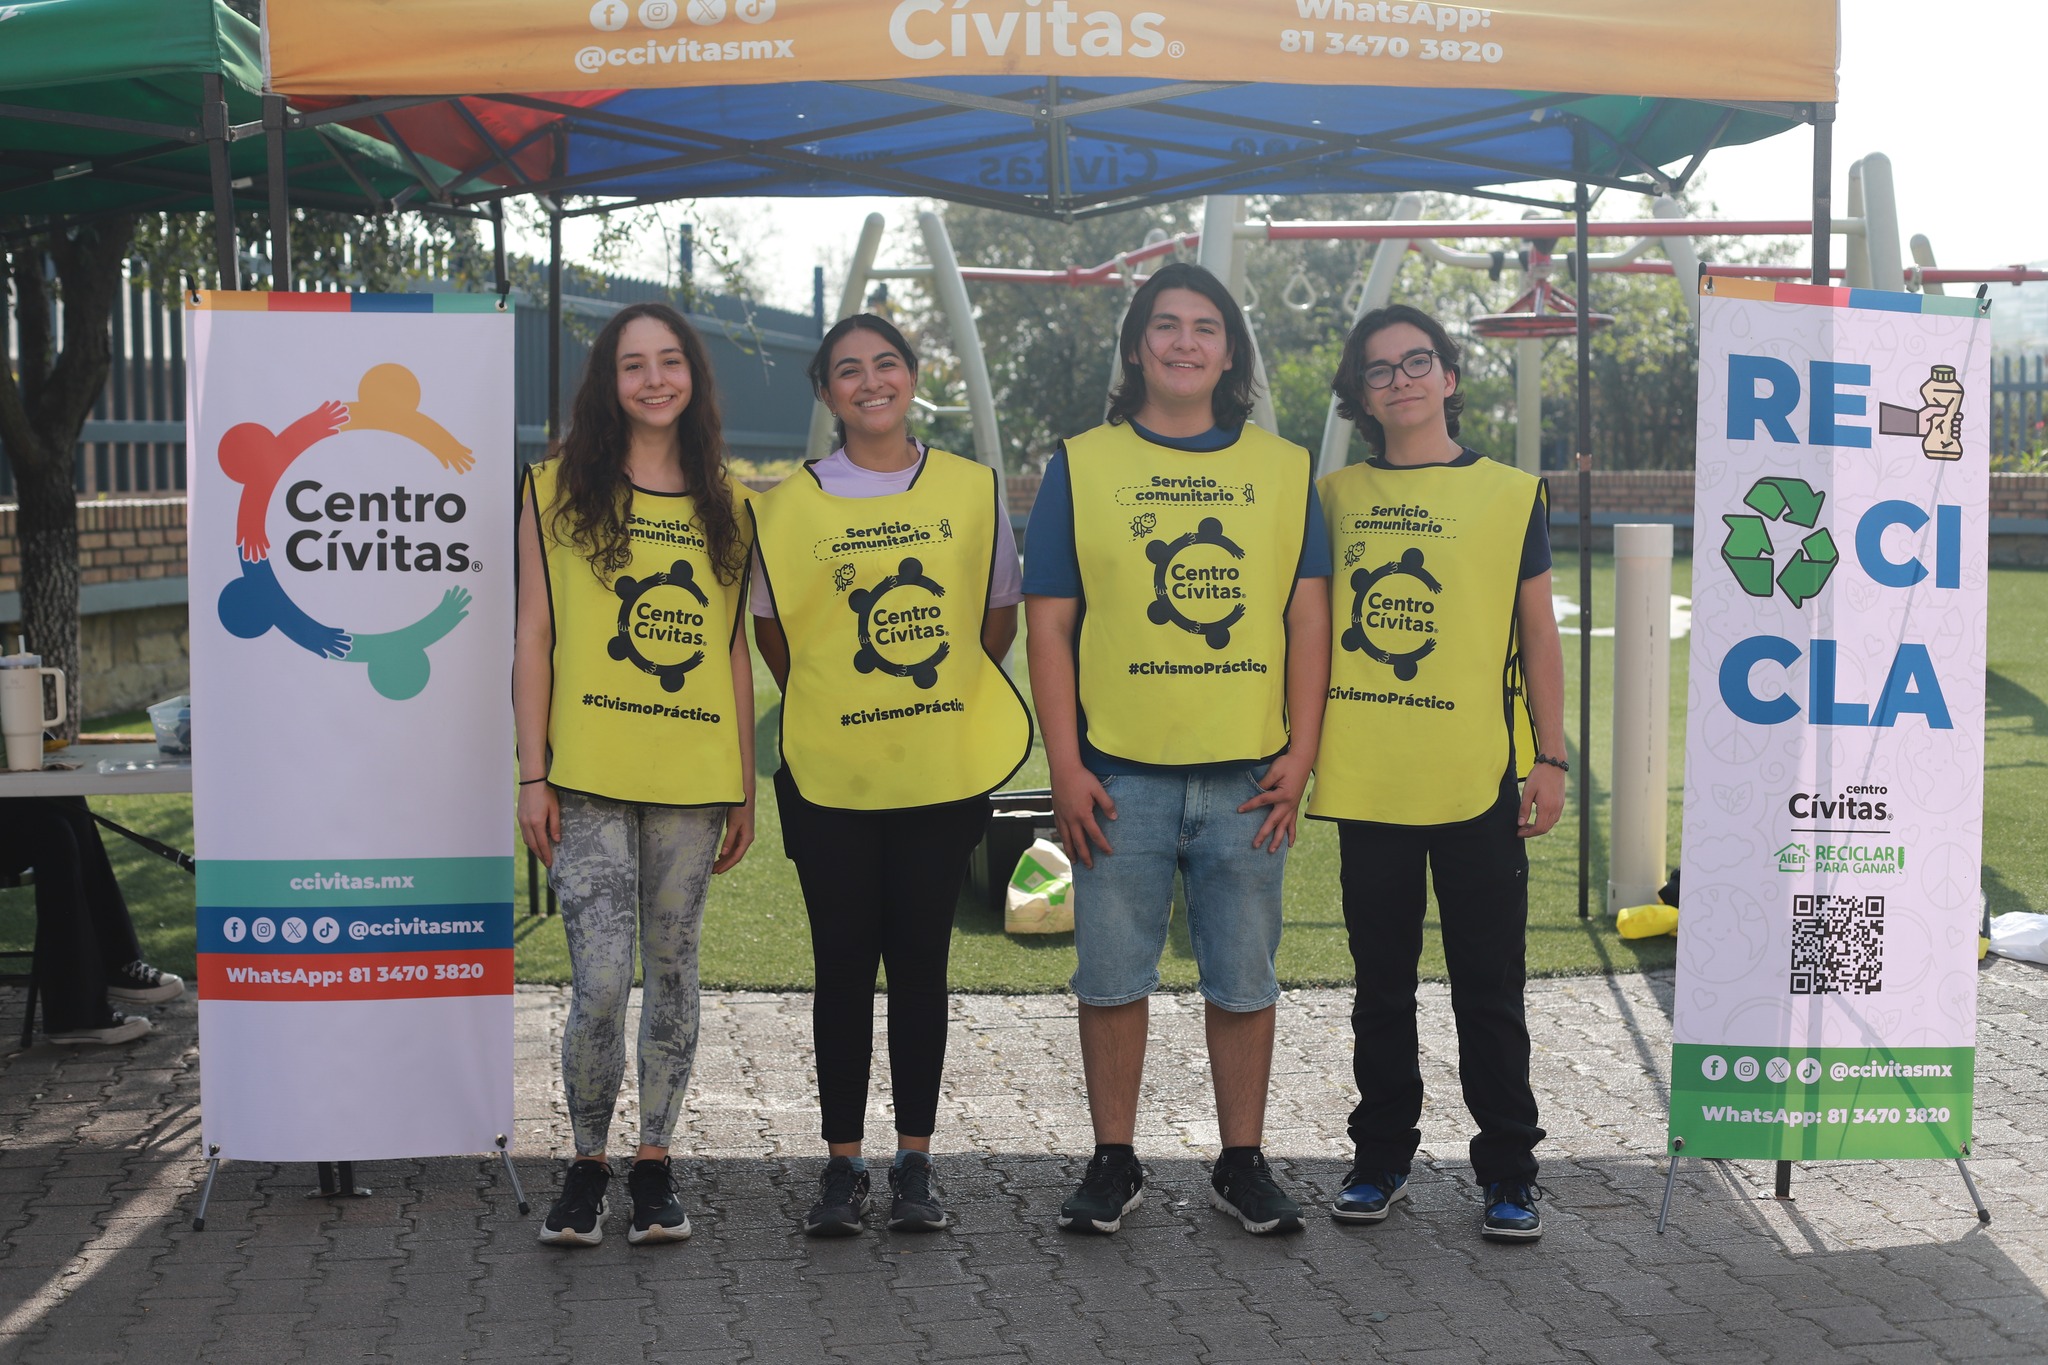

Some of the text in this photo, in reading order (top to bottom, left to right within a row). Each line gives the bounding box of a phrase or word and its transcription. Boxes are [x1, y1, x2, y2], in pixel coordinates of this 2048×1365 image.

[1296, 0, 1491, 33] WhatsApp:
[574, 37, 795, 74] @ccivitasmx
[1280, 29, 1503, 63] 81 3470 3820
[1726, 353, 1873, 449] RE
[1151, 476, 1217, 488] Servicio
[285, 480, 467, 523] Centro
[1135, 489, 1234, 502] comunitario
[1371, 504, 1429, 519] Servicio
[846, 521, 912, 539] Servicio
[1354, 518, 1443, 534] comunitario
[831, 530, 931, 553] comunitario
[1855, 499, 1962, 590] CI
[1171, 564, 1240, 581] Centro
[636, 602, 704, 627] Centro
[1368, 592, 1435, 615] Centro
[873, 606, 941, 627] Centro
[1128, 658, 1268, 675] #CivismoPráctico
[1718, 635, 1954, 730] CLA
[582, 693, 721, 724] #CivismoPráctico
[1328, 685, 1456, 711] CivismoPráctico
[1846, 784, 1888, 795] centro
[1815, 861, 1849, 874] PARA
[290, 872, 415, 891] ccivitas.mx
[349, 917, 485, 941] @ccivitasmx
[226, 963, 485, 988] WhatsApp: 81 3470 3820
[1829, 1060, 1953, 1082] @ccivitasmx
[1701, 1105, 1950, 1128] WhatsApp: 81 3470 3820
